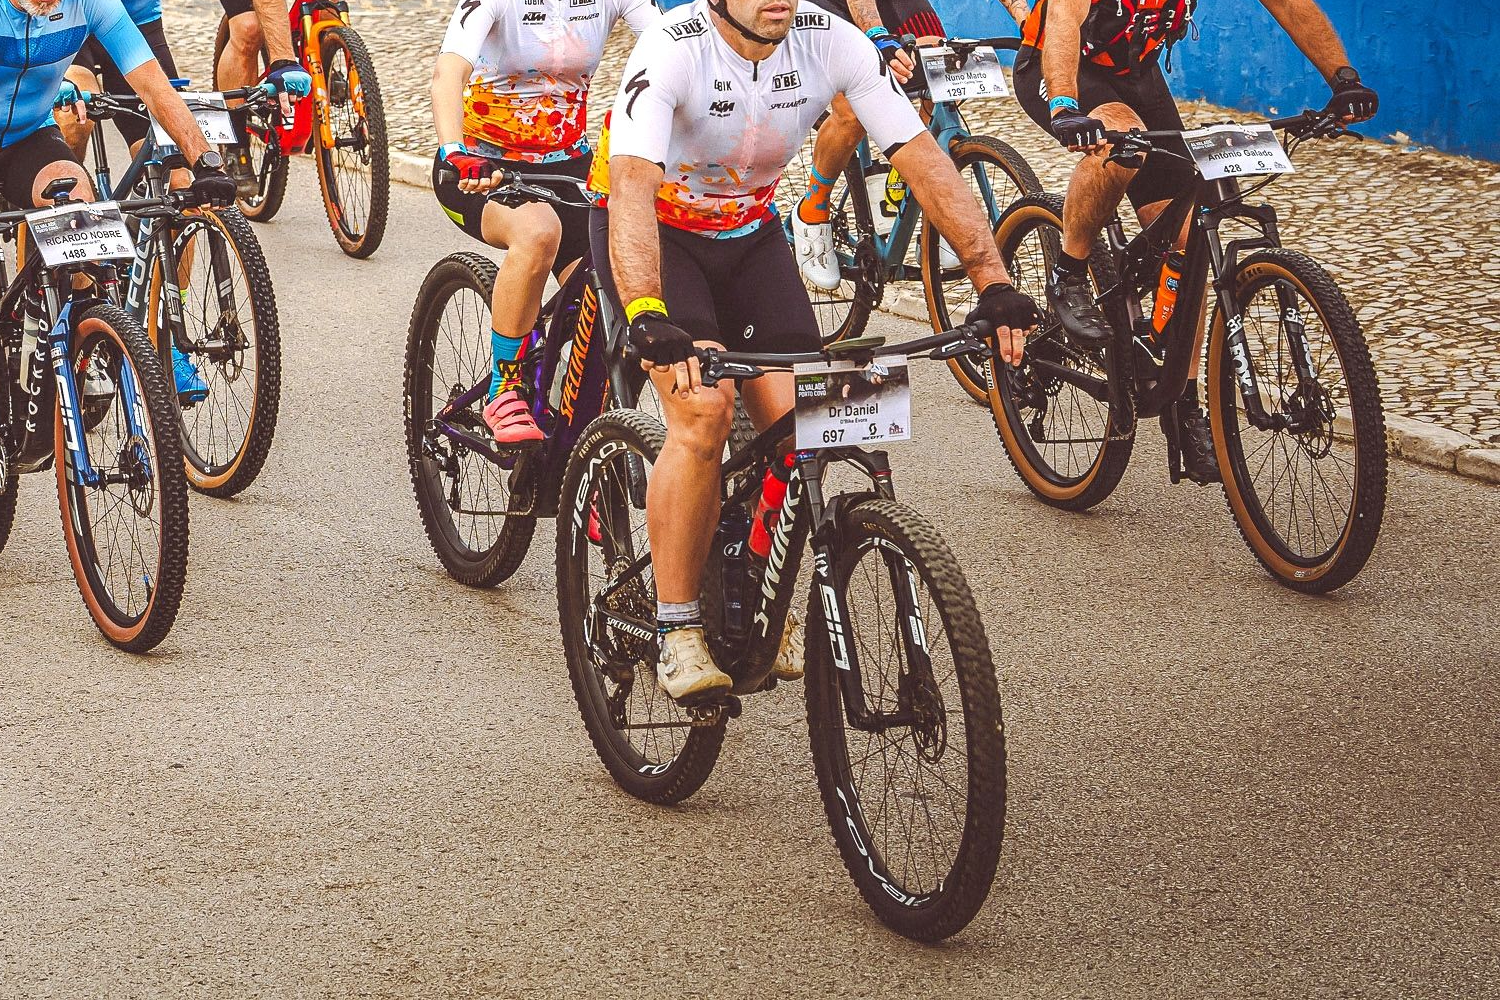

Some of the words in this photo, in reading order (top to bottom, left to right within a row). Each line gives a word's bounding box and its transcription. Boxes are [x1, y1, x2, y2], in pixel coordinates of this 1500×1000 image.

[522, 11, 547, 22] KTM
[944, 74, 965, 82] Nuno
[946, 87, 966, 97] 1297
[1208, 149, 1242, 161] António
[1243, 149, 1274, 157] Galado
[1223, 163, 1242, 174] 428
[44, 232, 88, 247] RICARDO
[90, 230, 123, 240] NOBRE
[62, 248, 87, 260] 1488
[560, 284, 598, 426] SPECIALIZED
[1230, 343, 1253, 388] FOX
[798, 383, 826, 392] ALVALADE
[828, 407, 842, 418] Dr
[845, 403, 879, 416] Daniel
[822, 429, 845, 443] 697
[606, 616, 654, 641] SPECIALIZED
